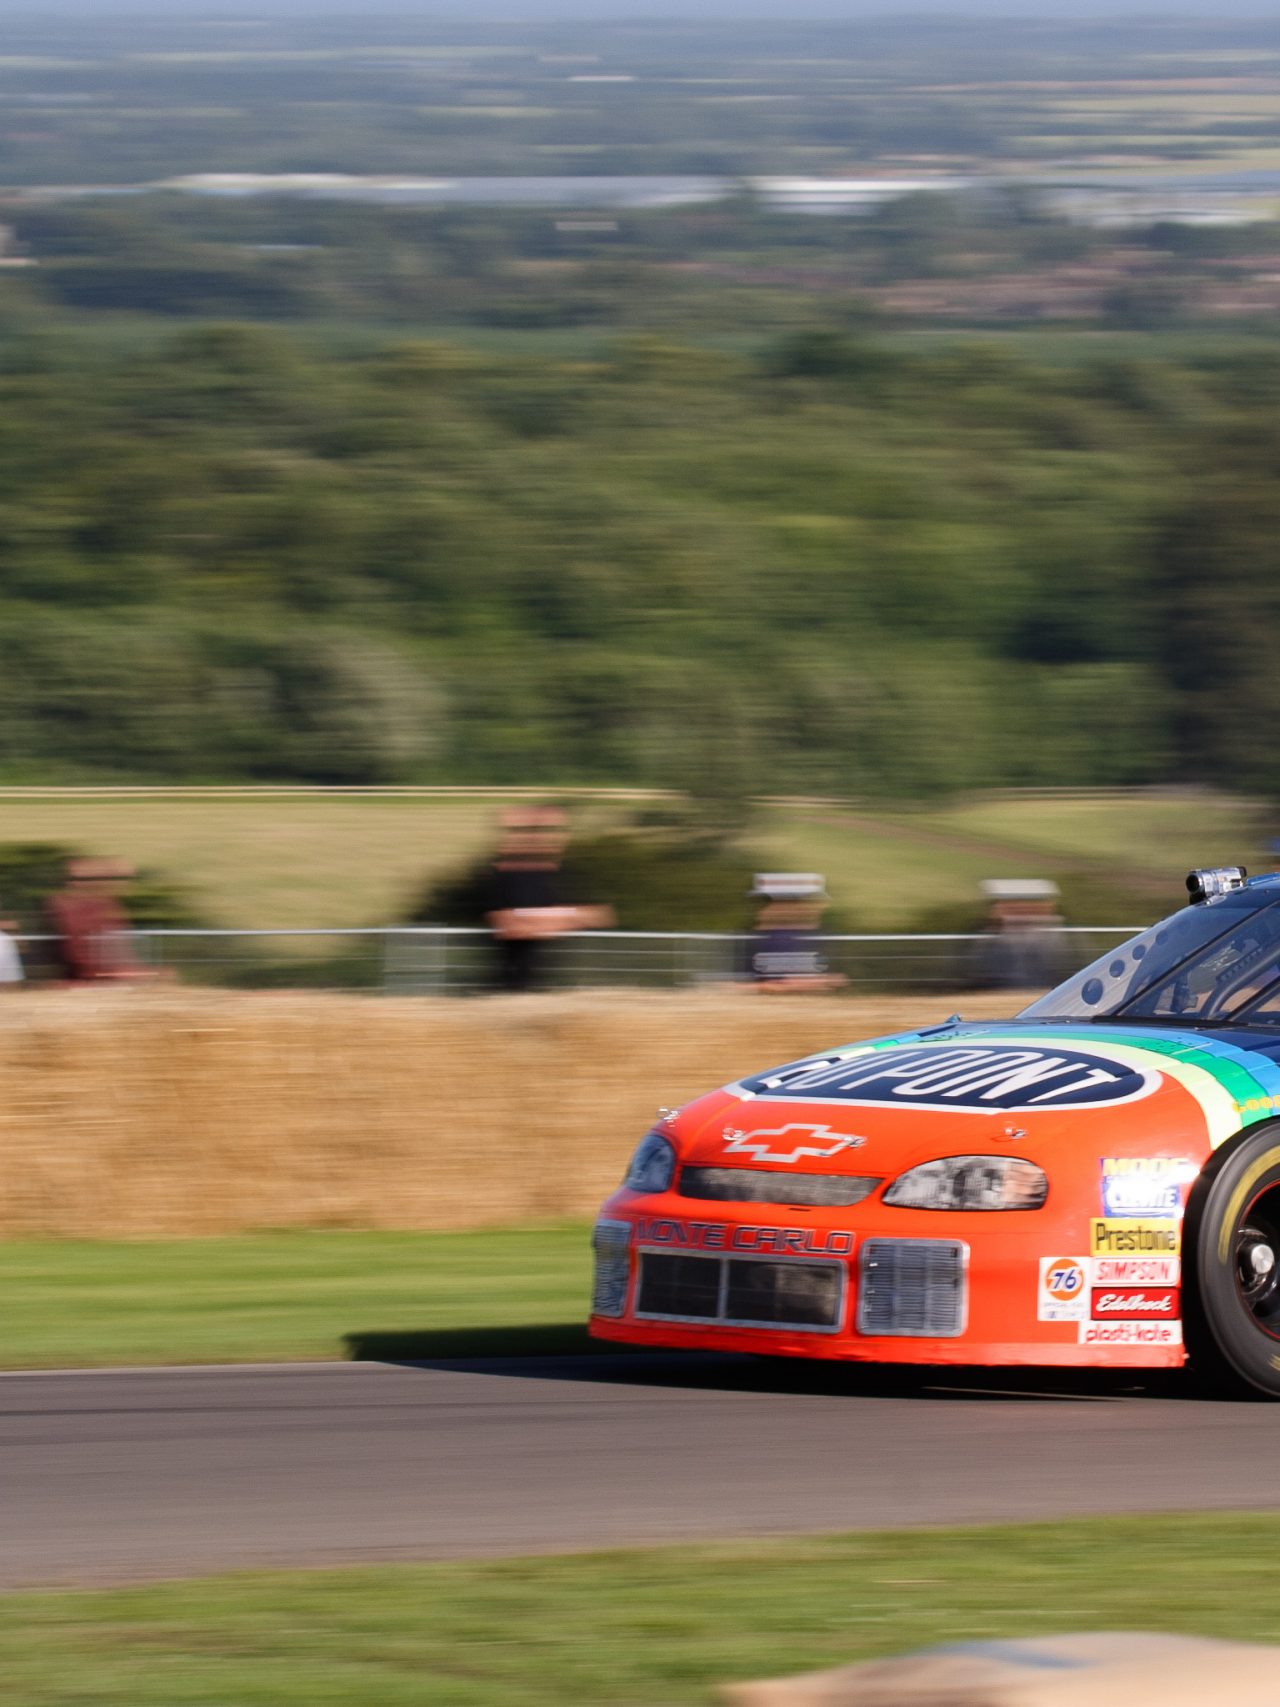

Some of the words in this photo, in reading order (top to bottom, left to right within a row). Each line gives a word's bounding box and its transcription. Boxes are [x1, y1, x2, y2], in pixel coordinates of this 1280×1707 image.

[634, 1218, 726, 1247] MONTE
[733, 1224, 855, 1255] CARLO
[1096, 1222, 1176, 1251] Prestone
[1053, 1268, 1078, 1290] 76
[1097, 1261, 1170, 1280] SIMPSON
[1096, 1294, 1172, 1312] Edelbrock
[1085, 1323, 1172, 1342] plasti-kote
